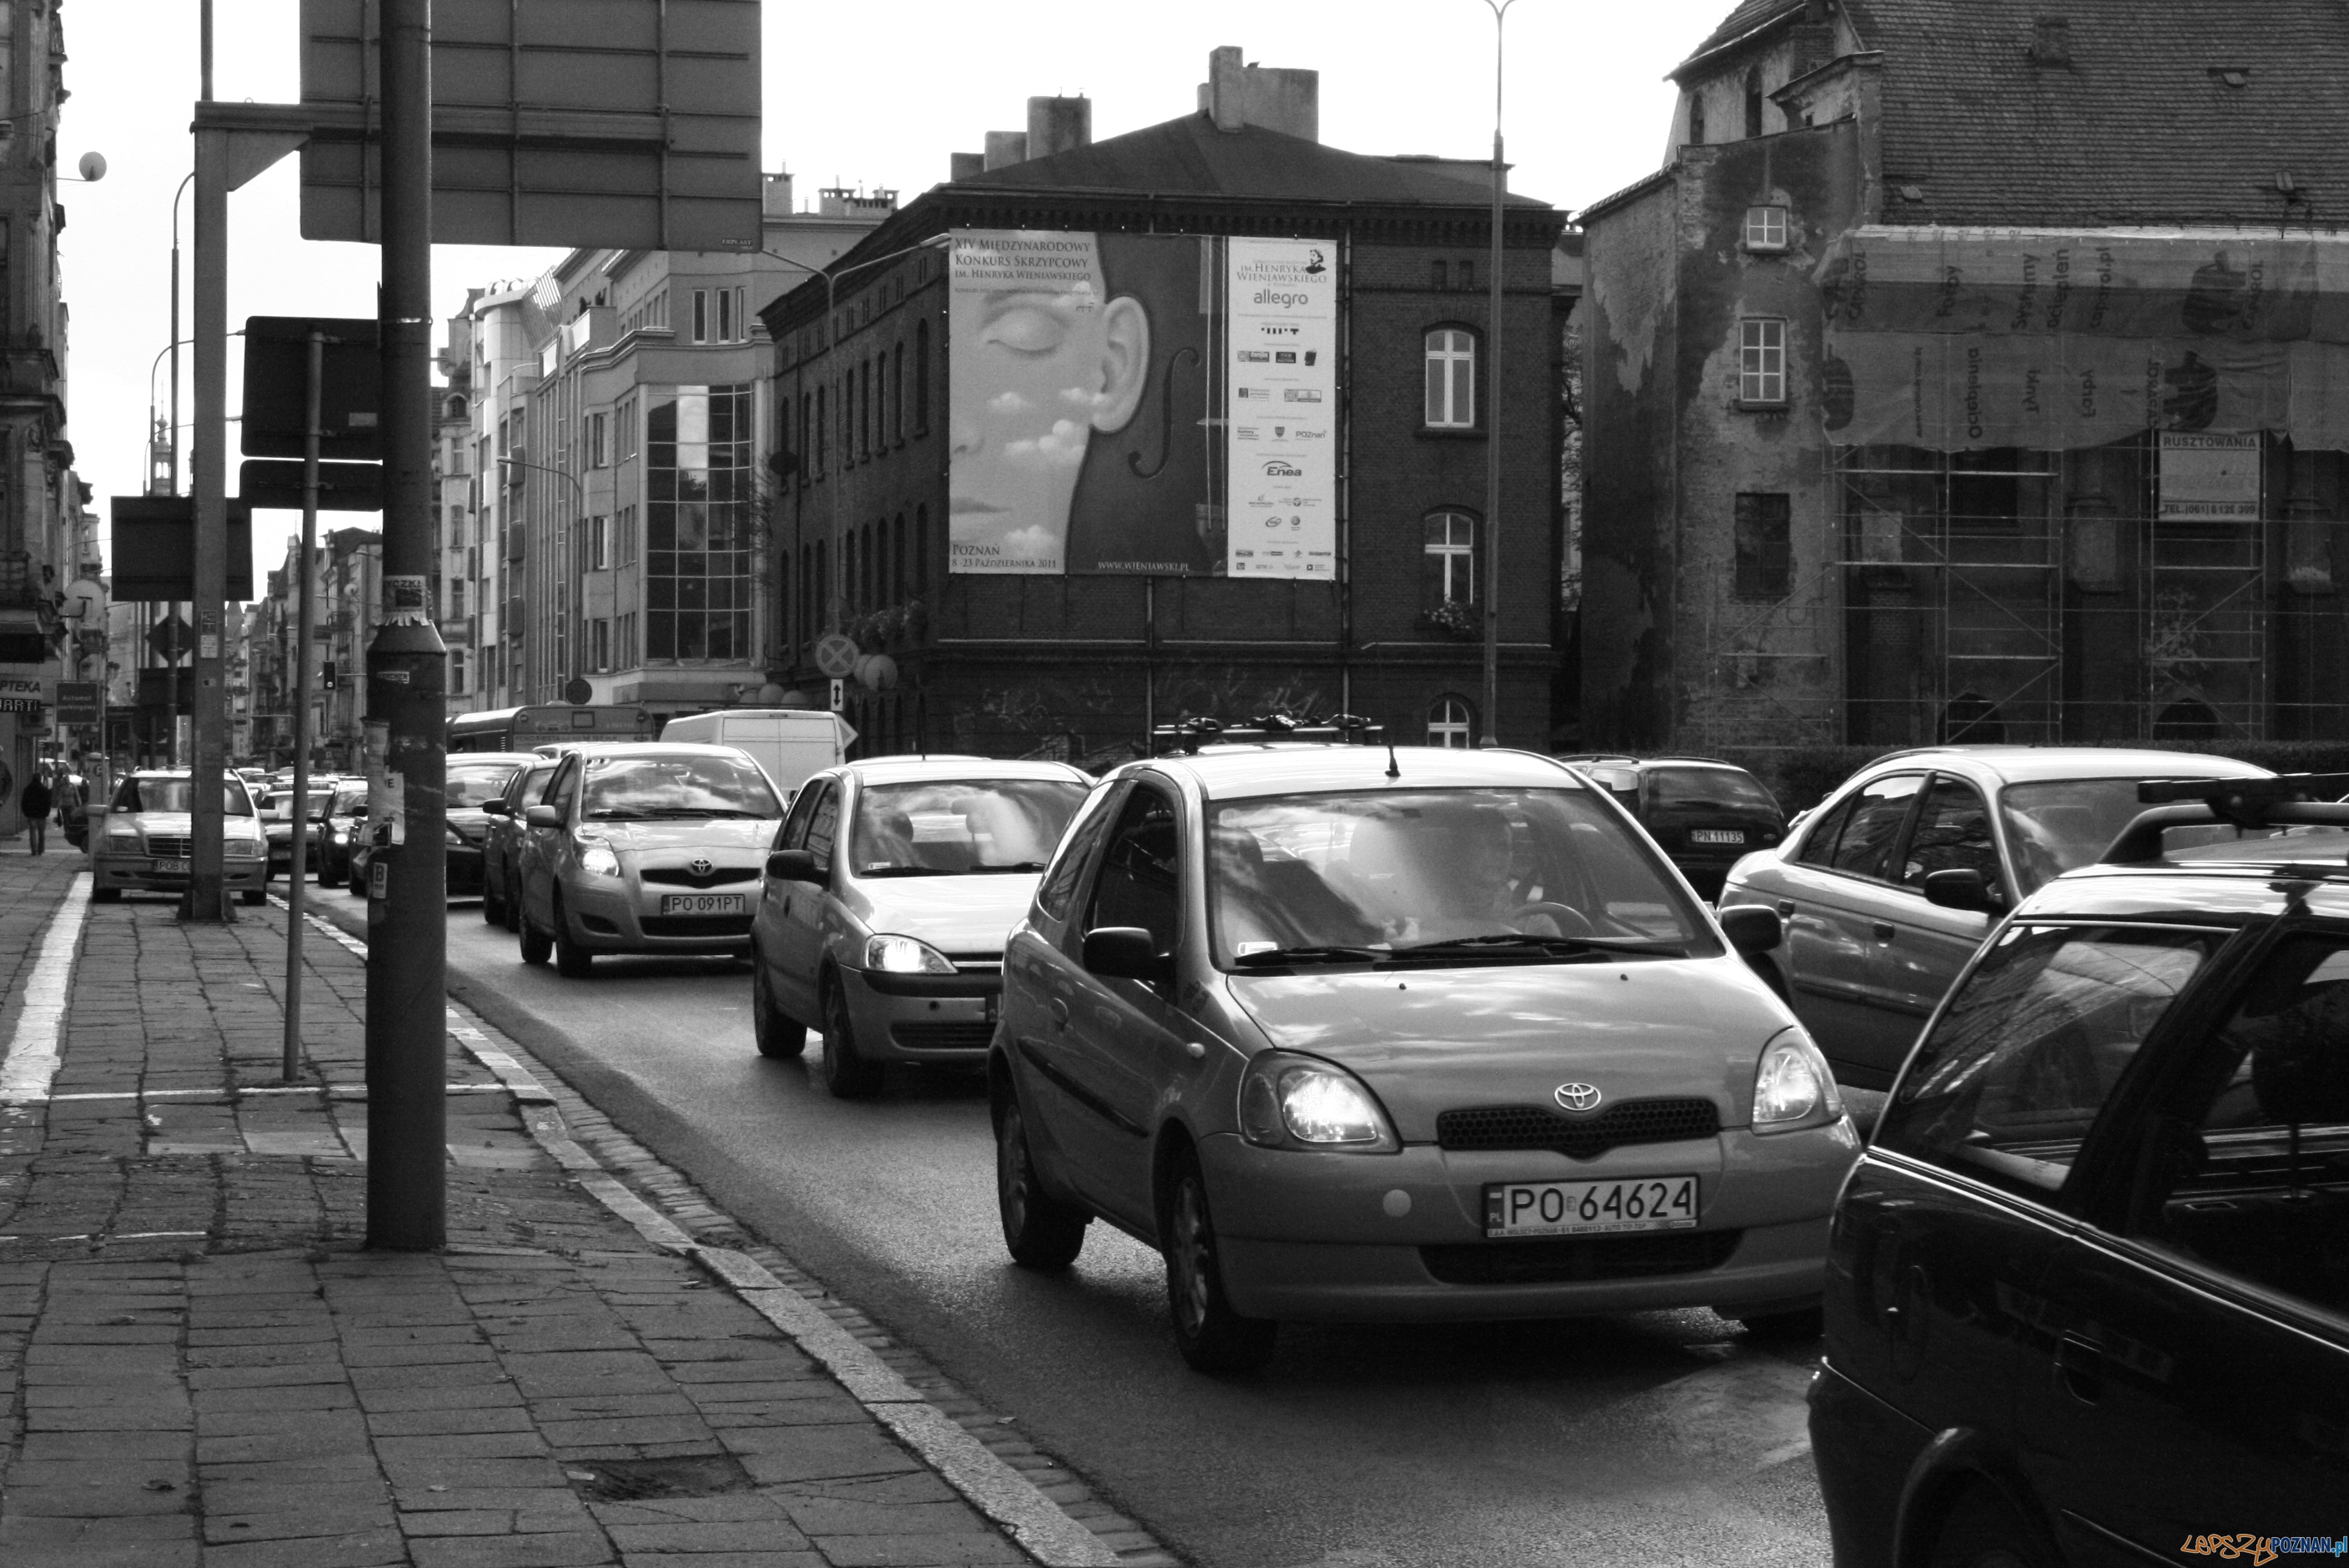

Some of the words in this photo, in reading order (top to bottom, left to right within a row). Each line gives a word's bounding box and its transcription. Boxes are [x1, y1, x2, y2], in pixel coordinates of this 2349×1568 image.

[955, 239, 975, 249] XIV
[979, 239, 1090, 253] MIĘDZYNARODOWY
[956, 254, 1010, 266] KONKURS
[1014, 255, 1089, 269] SKRZYPCOWY
[1255, 263, 1307, 274] HENRYKA
[972, 269, 1014, 279] HENRYKA
[1016, 270, 1091, 281] WIENIAWSKIEGO
[1236, 271, 1326, 284] WIENIAWSKIEGO
[2089, 247, 2115, 329] caparol.pl
[1253, 289, 1308, 309] allegro
[2163, 436, 2256, 448] RUSZTOWANIA
[2162, 504, 2185, 513] TEL.
[953, 544, 1000, 555] POZNAŃ
[975, 558, 1036, 568] PAŹDZIERNIKA
[1038, 559, 1056, 568] 2011
[1697, 831, 1711, 842] PN
[672, 897, 692, 911] PO
[697, 897, 742, 911] 091PT
[1511, 1188, 1564, 1224] PO
[1578, 1179, 1692, 1221] 64624
[1489, 1212, 1502, 1224] PL
